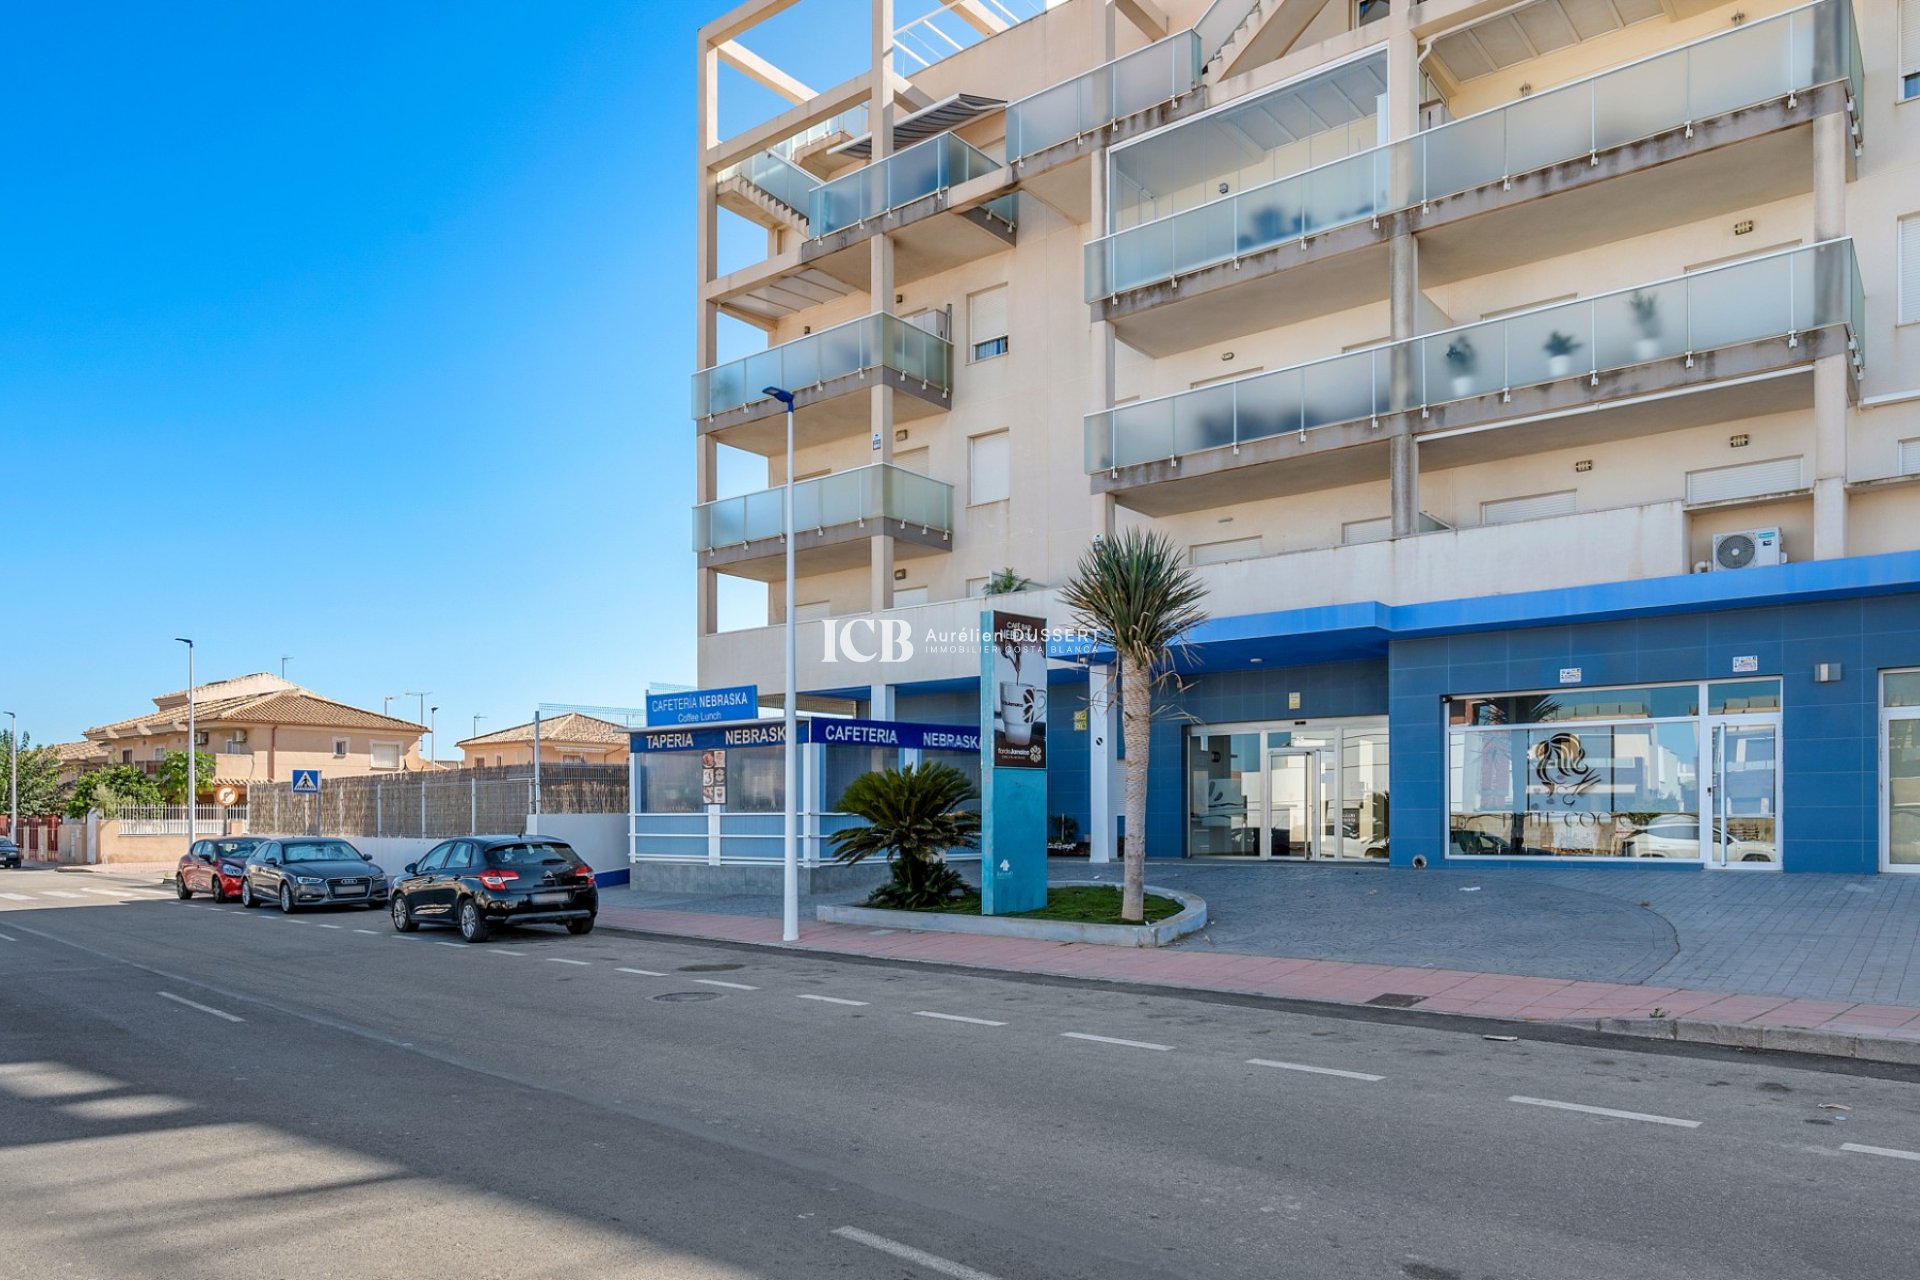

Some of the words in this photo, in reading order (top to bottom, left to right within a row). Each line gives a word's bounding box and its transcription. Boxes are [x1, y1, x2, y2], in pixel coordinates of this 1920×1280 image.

[699, 691, 748, 708] NEBRASKA
[678, 713, 699, 723] Coffee
[700, 711, 722, 721] Lunch
[646, 732, 694, 749] TAPERIA
[725, 726, 786, 745] NEBRASK
[825, 725, 899, 744] CAFETERIA
